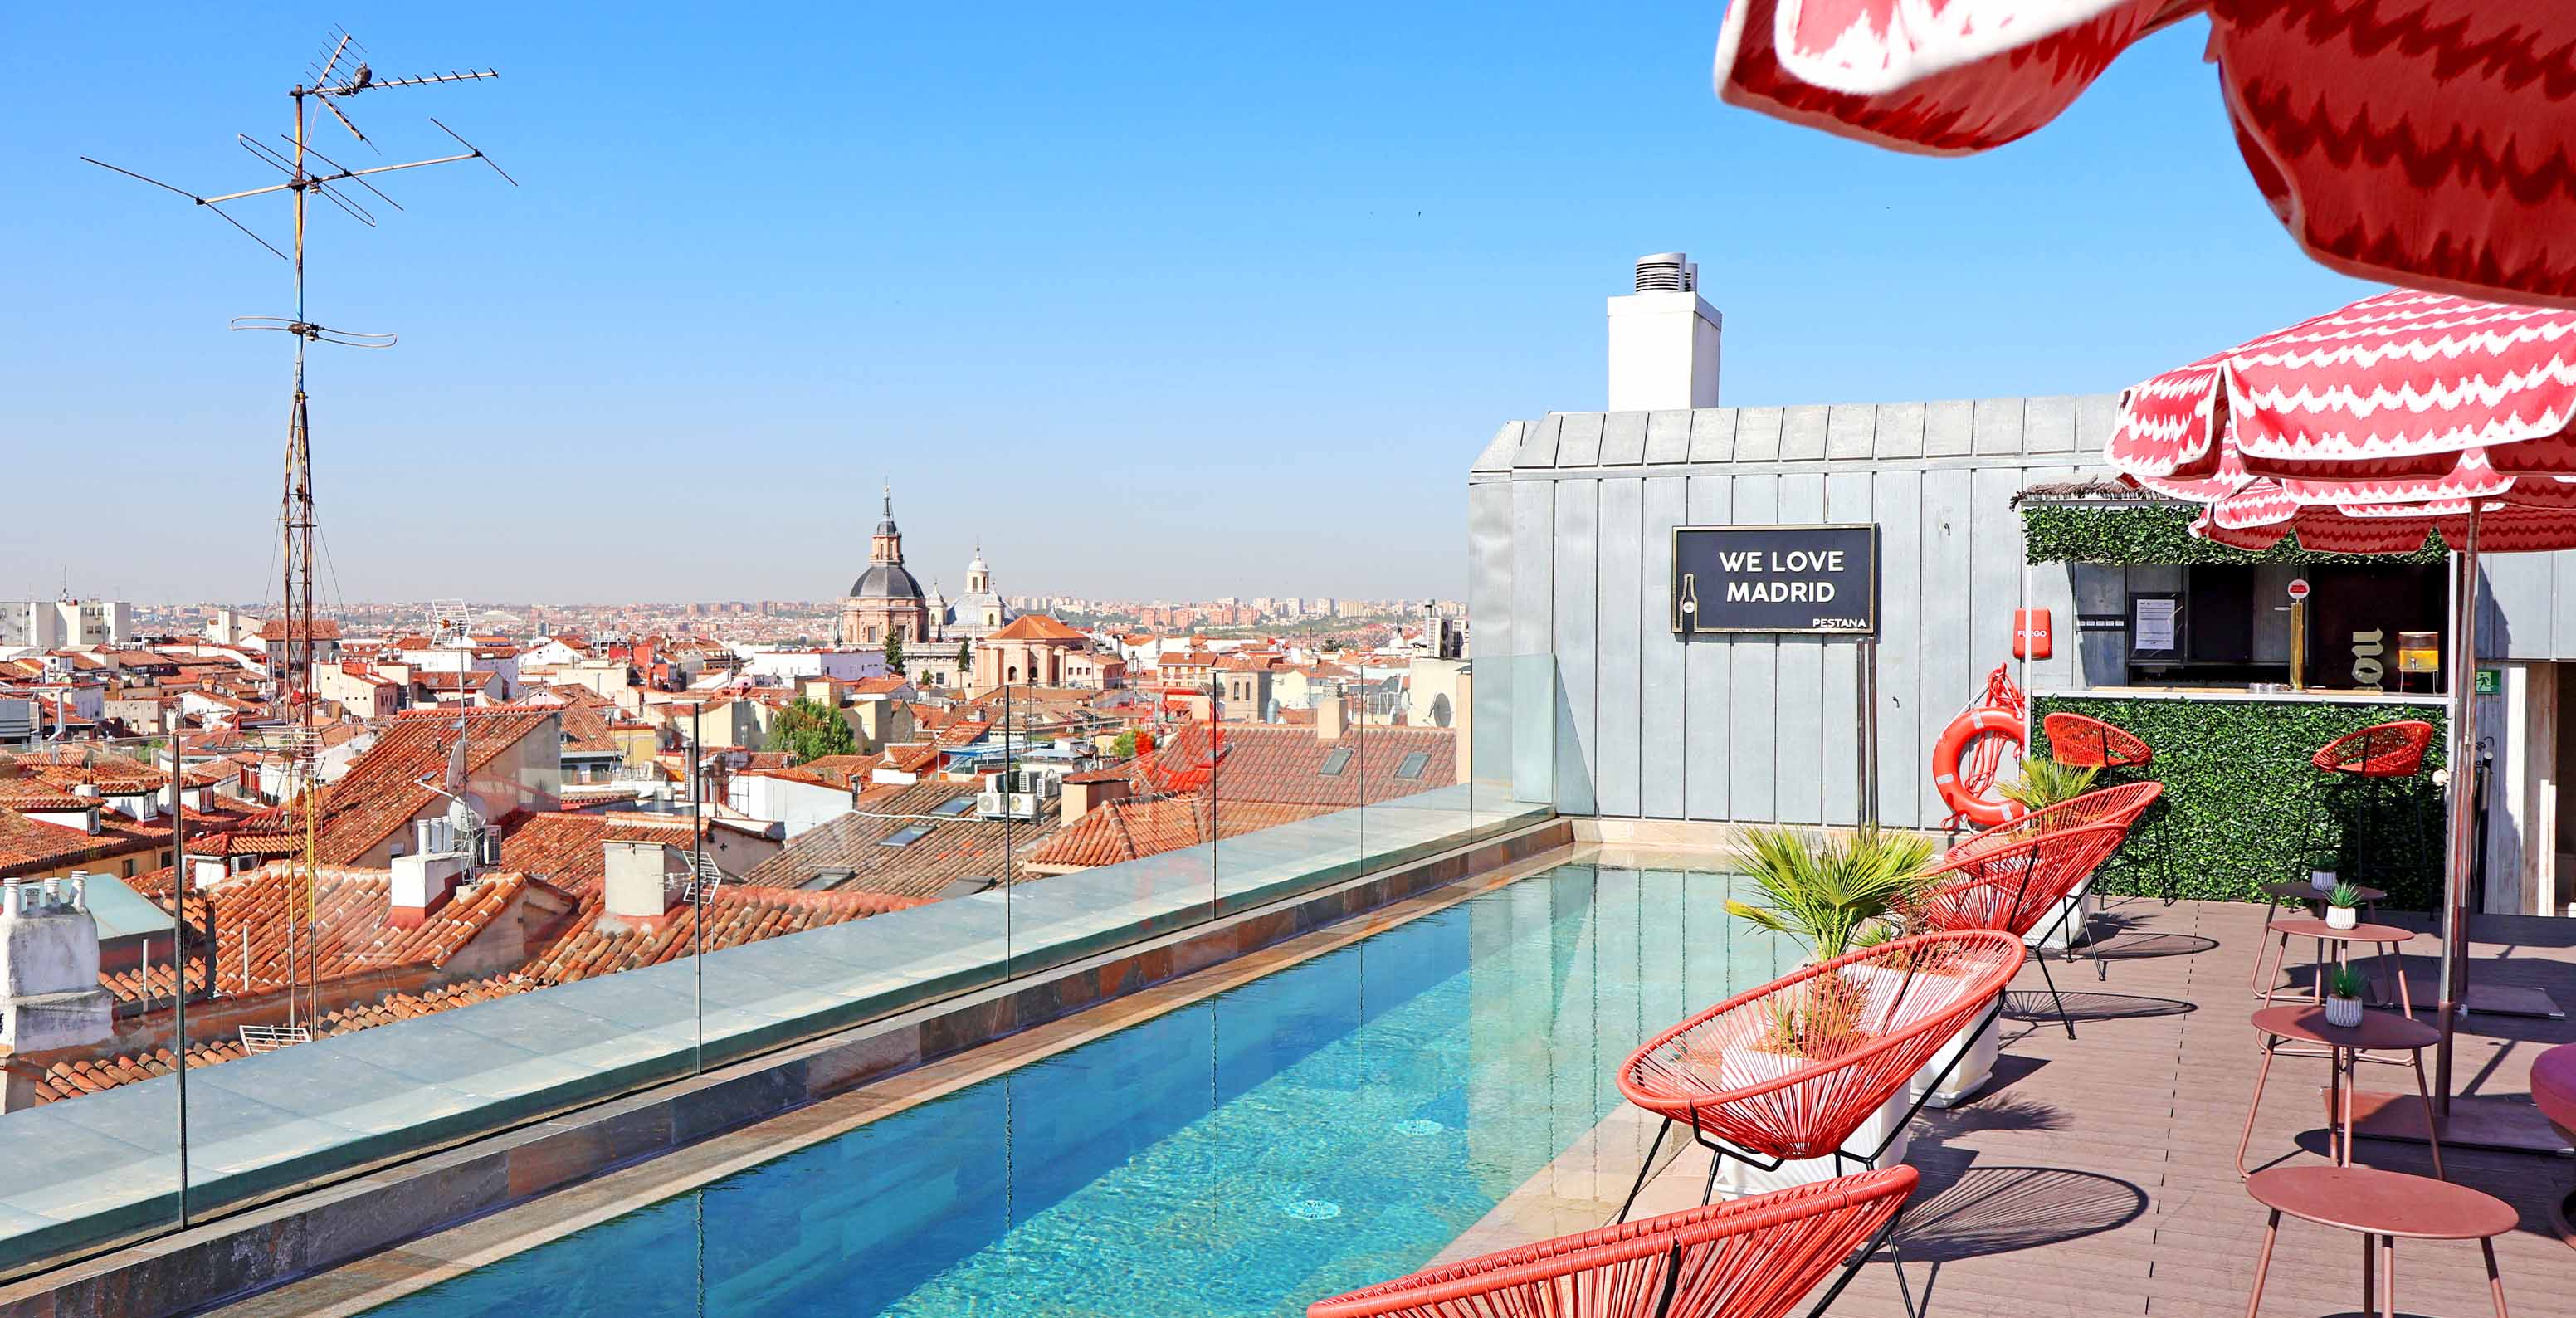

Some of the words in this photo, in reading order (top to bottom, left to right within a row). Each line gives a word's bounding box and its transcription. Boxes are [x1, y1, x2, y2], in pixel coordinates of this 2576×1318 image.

[1719, 551, 1762, 572] WE
[1772, 550, 1844, 572] LOVE
[1726, 582, 1835, 603] MADRID
[1812, 618, 1866, 628] PESTANA
[2351, 627, 2384, 691] ou
